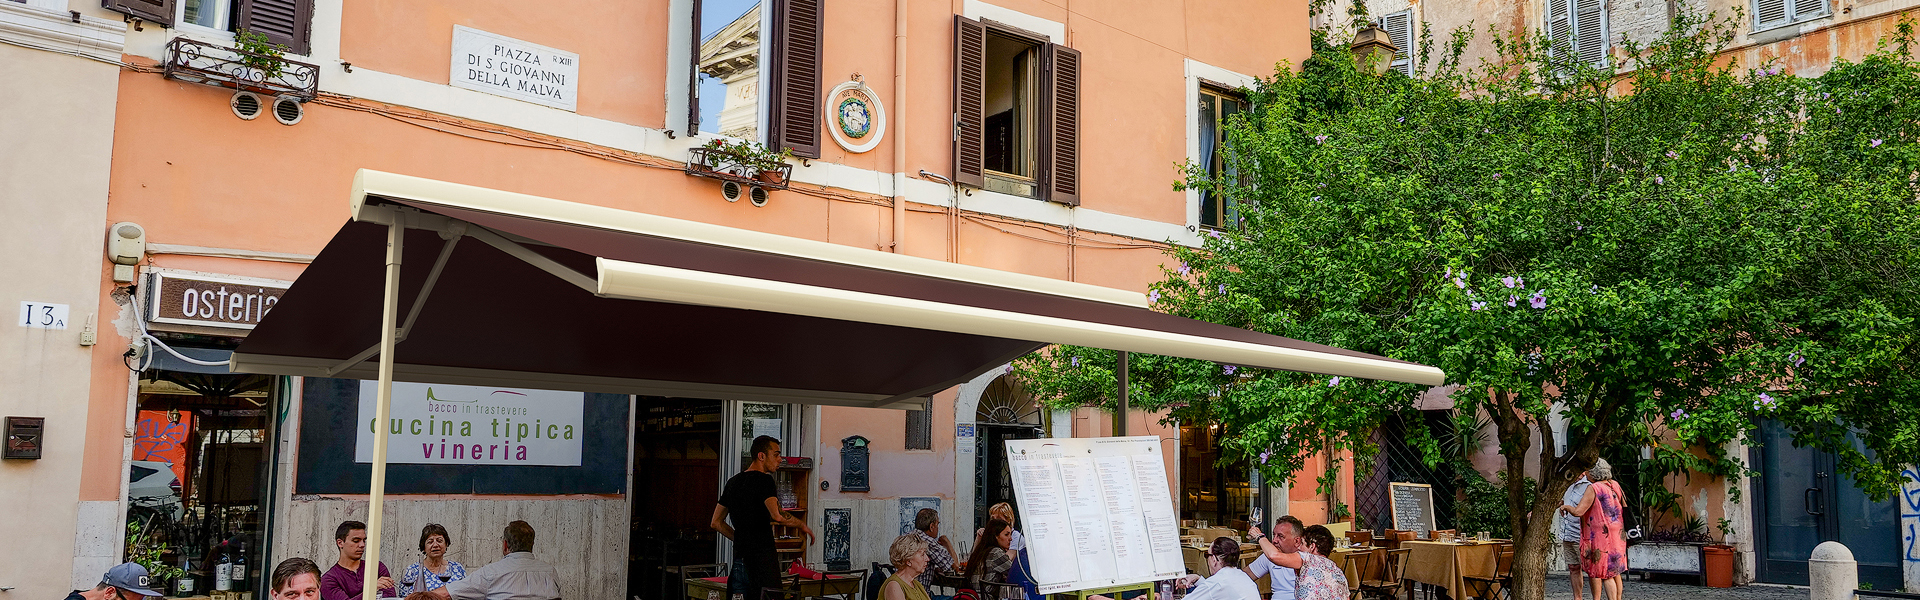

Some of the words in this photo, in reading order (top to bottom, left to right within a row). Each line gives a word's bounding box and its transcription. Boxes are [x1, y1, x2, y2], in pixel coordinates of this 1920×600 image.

[494, 44, 541, 66] PIAZZA
[559, 56, 572, 66] XIII
[468, 53, 481, 66] DI
[500, 61, 565, 86] GIOVANNI
[468, 68, 511, 89] DELLA
[516, 79, 562, 99] MALVA
[428, 401, 457, 413] bacco
[462, 403, 471, 413] in
[476, 404, 528, 416] trastevere
[491, 418, 574, 442] tipica
[422, 439, 527, 461] vineria
